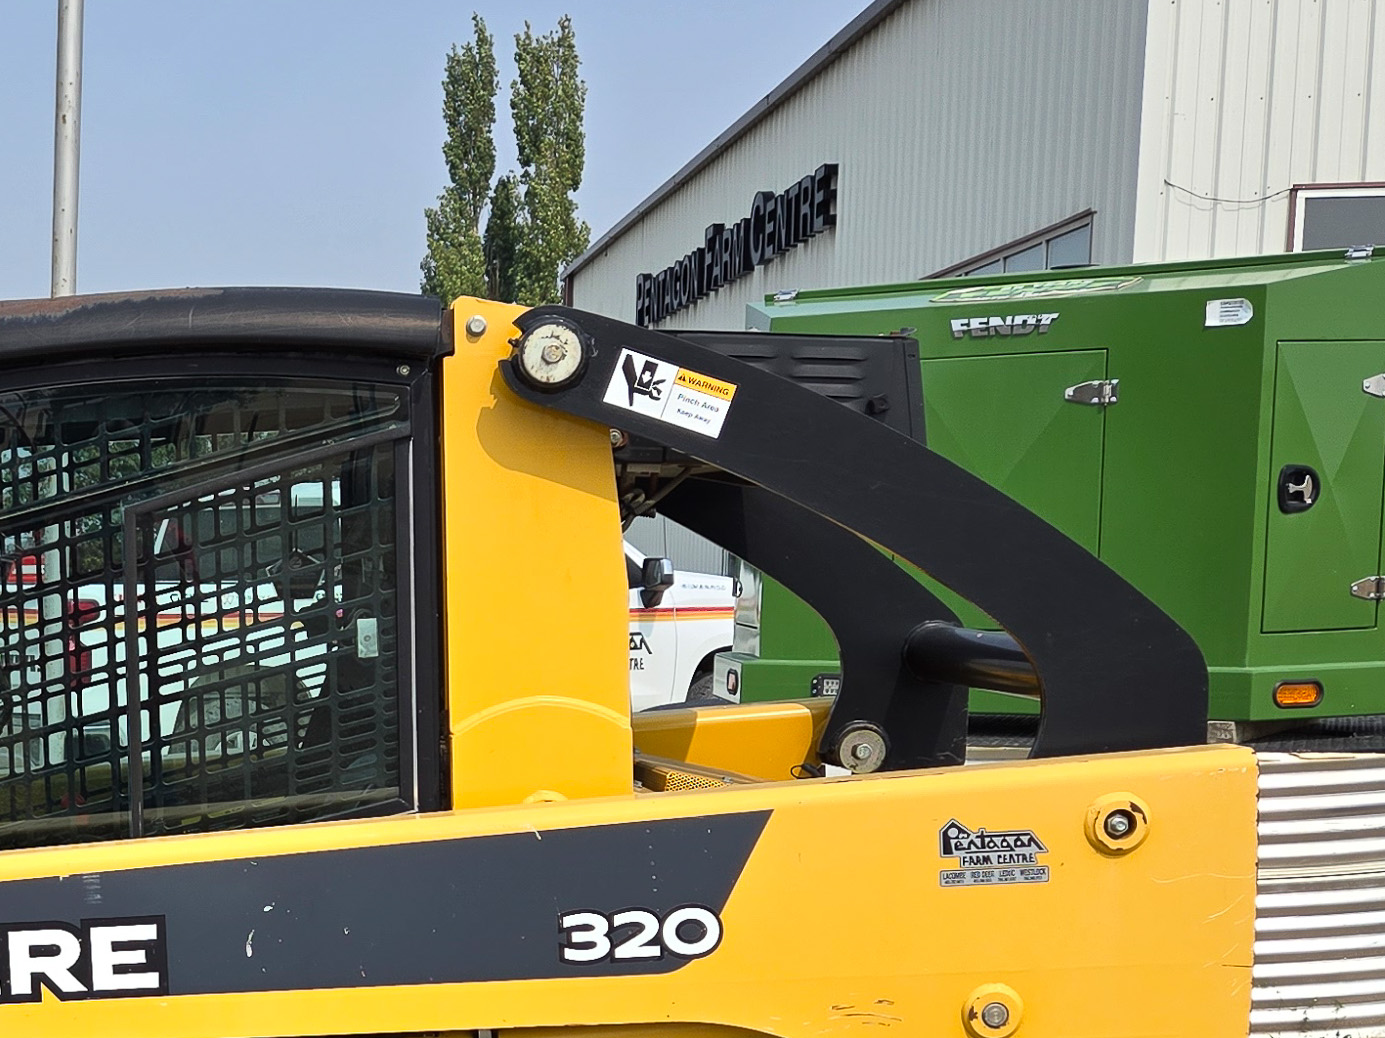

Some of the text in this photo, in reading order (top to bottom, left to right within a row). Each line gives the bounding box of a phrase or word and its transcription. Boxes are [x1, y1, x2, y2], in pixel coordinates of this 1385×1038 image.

[636, 163, 839, 327] PENTAGON FARM CENTRE
[950, 313, 1060, 338] FENDT
[688, 376, 730, 396] WARNING
[677, 393, 720, 413] Pinch Area
[677, 408, 711, 424] Keep Away
[629, 657, 645, 670] TRE
[943, 822, 1044, 855] Pentagon
[962, 853, 1035, 866] FARM CENTRE
[562, 907, 721, 962] 320
